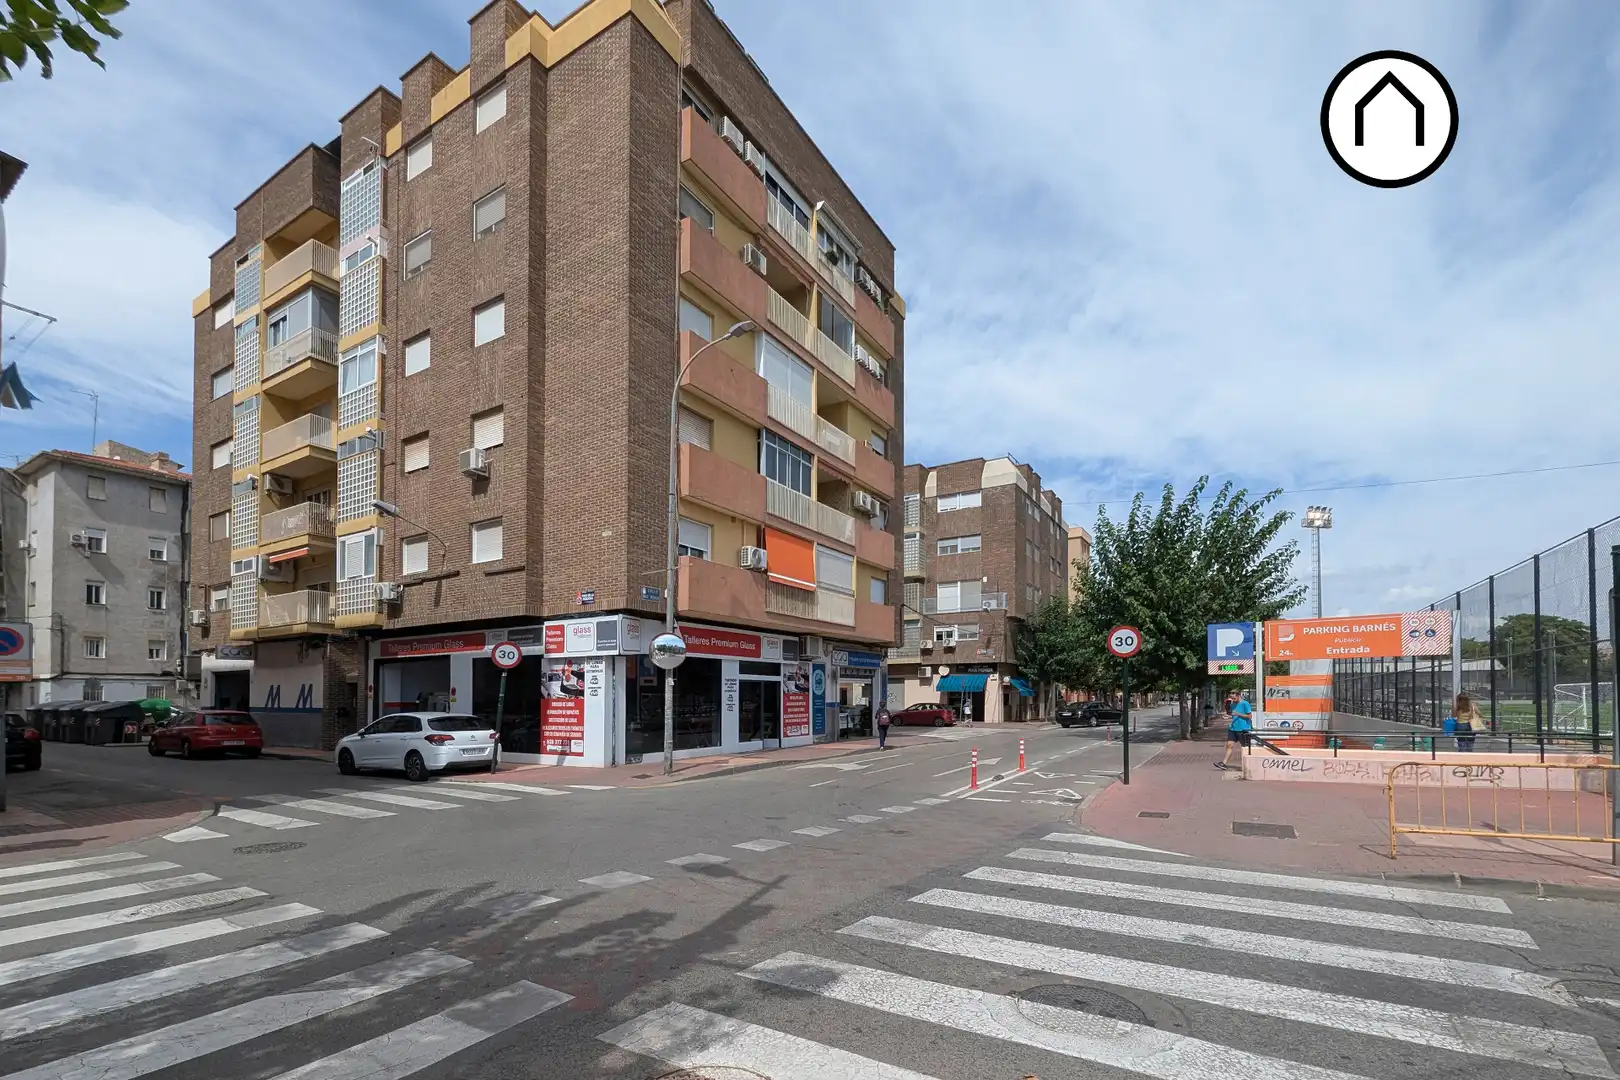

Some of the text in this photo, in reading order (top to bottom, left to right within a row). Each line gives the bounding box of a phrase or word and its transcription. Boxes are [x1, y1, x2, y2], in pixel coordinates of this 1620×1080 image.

[573, 626, 592, 636] glass
[1303, 622, 1396, 635] PARKING BARNÉS
[412, 641, 442, 652] Premium
[444, 640, 464, 649] Glass
[684, 634, 756, 651] Talleres Premium Glass
[1115, 636, 1134, 647] 30
[1216, 628, 1244, 657] P
[498, 649, 515, 660] 30
[1326, 645, 1370, 655] Entrada
